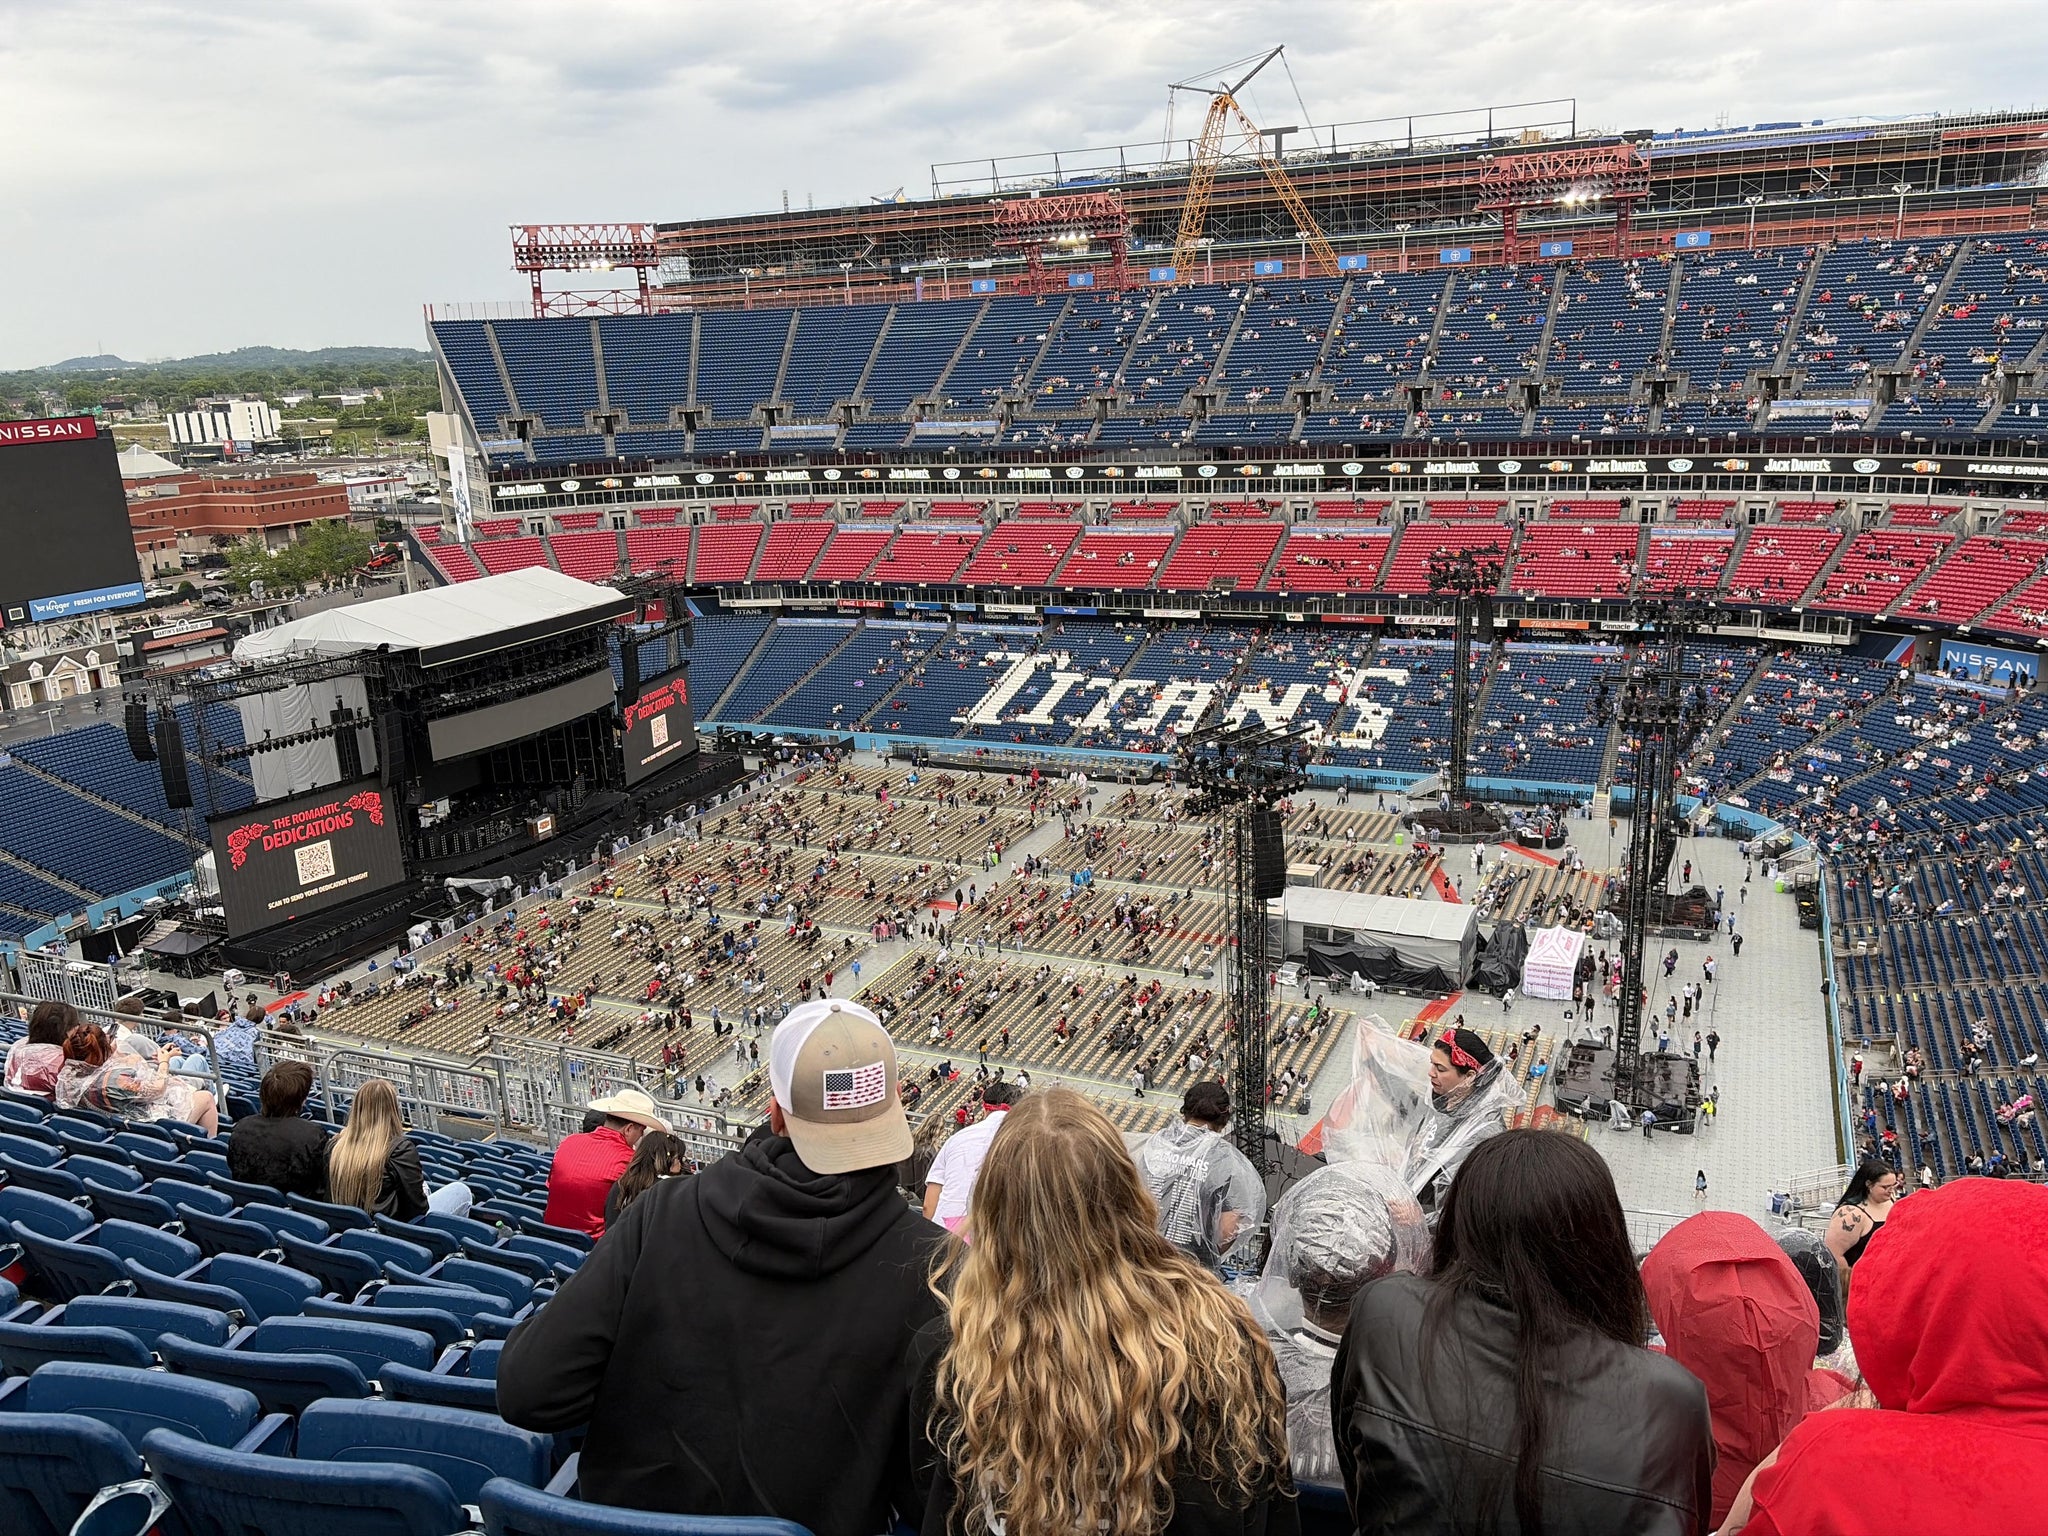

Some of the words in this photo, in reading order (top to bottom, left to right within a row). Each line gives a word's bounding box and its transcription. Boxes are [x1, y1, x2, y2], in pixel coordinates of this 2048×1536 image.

[0, 422, 82, 440] NISSAN
[1273, 464, 1293, 476] JACK
[1423, 462, 1445, 474] JACK
[1586, 460, 1610, 472] JACK
[1764, 458, 1790, 472] JACK
[1968, 463, 2014, 475] PLEASE
[765, 471, 782, 481] JACK
[888, 468, 905, 479] JACK
[1007, 468, 1024, 479] JACK
[1135, 466, 1153, 478] JACK
[633, 476, 652, 487] JACK
[497, 486, 516, 497] JACK
[46, 600, 70, 614] Kroger
[74, 597, 93, 607] FRESH
[94, 595, 106, 604] FOR
[155, 627, 175, 637] MARTIN'S
[1602, 622, 1631, 630] Pinnacle
[1800, 644, 1842, 655] TITANS
[1946, 650, 2030, 675] NISSAN
[638, 693, 675, 720] DEDICATIONS
[272, 816, 291, 830] THE
[292, 802, 341, 824] ROMANTIC
[262, 811, 354, 852] DEDICATIONS
[267, 900, 283, 910] SCAN
[282, 897, 290, 905] TO
[304, 888, 319, 898] YOUR
[319, 879, 348, 893] DEDICATION
[348, 871, 369, 884] TONIGHT
[1180, 1155, 1210, 1172] MARS
